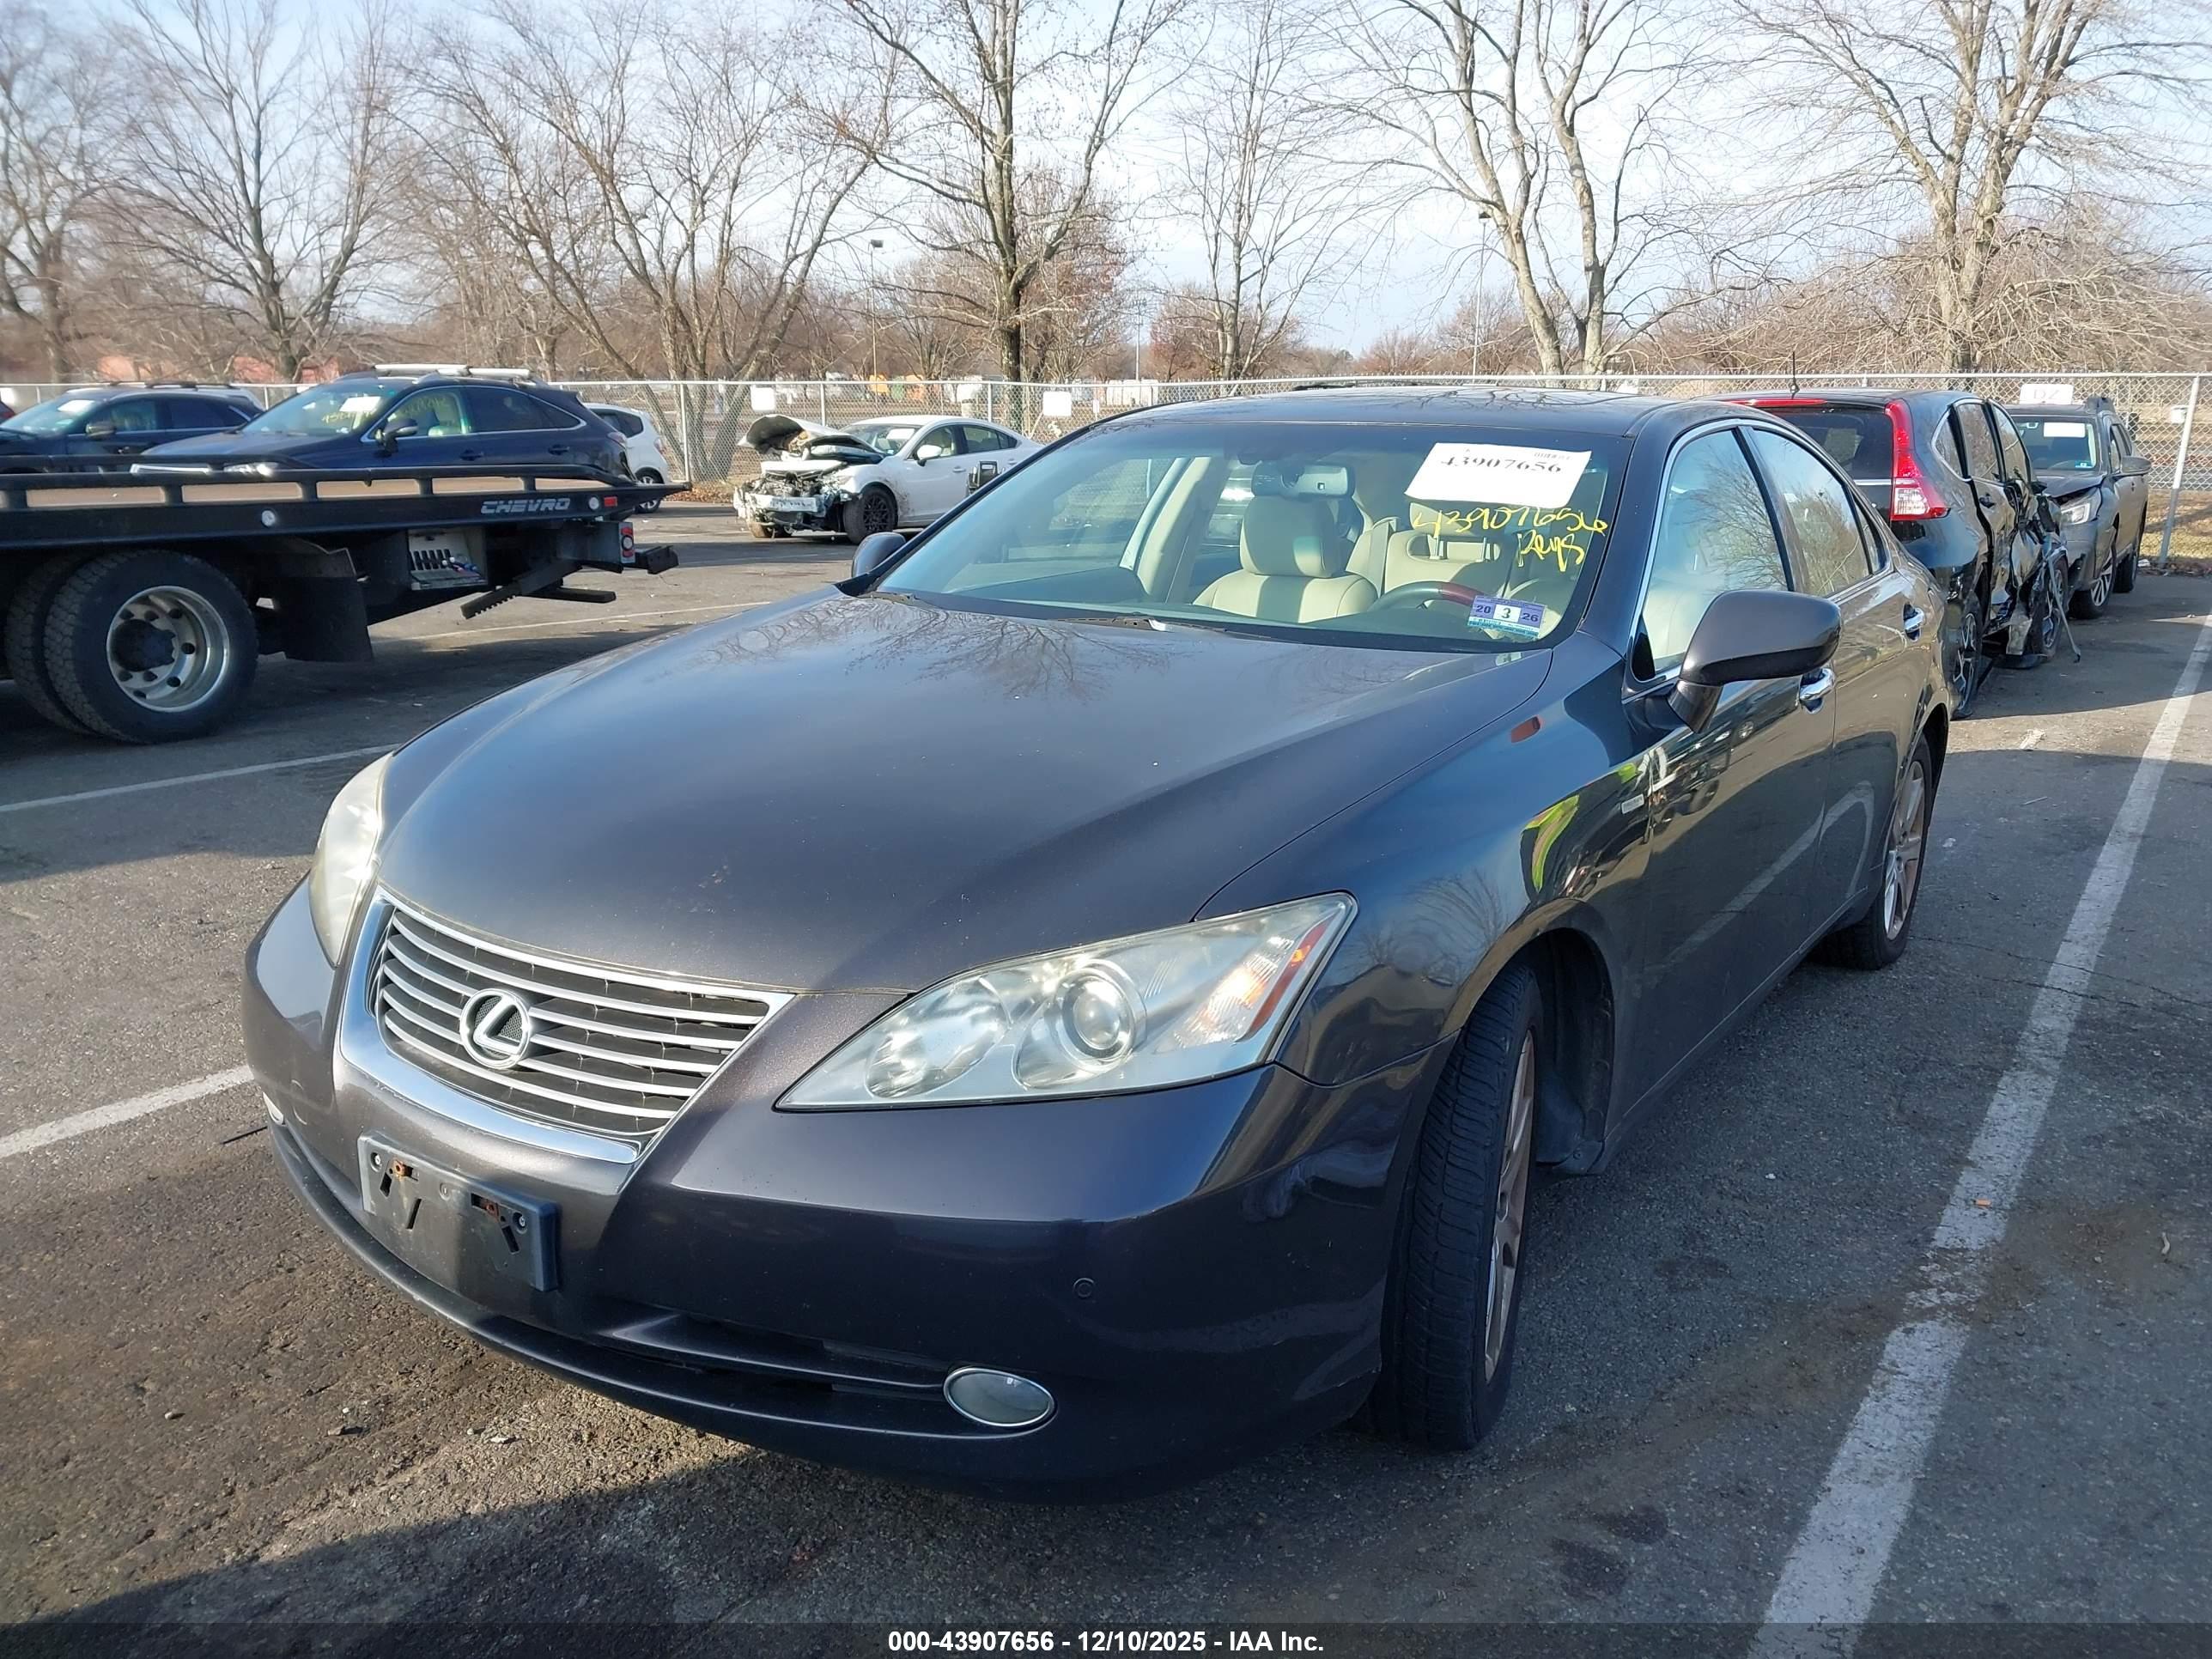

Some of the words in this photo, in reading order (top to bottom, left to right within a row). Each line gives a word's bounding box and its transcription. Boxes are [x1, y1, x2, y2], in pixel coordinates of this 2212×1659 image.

[1440, 455, 1562, 473] 43907656
[480, 497, 571, 514] CHEVRO
[1475, 605, 1492, 614] 20
[1501, 607, 1511, 619] 3
[1522, 612, 1540, 623] 26
